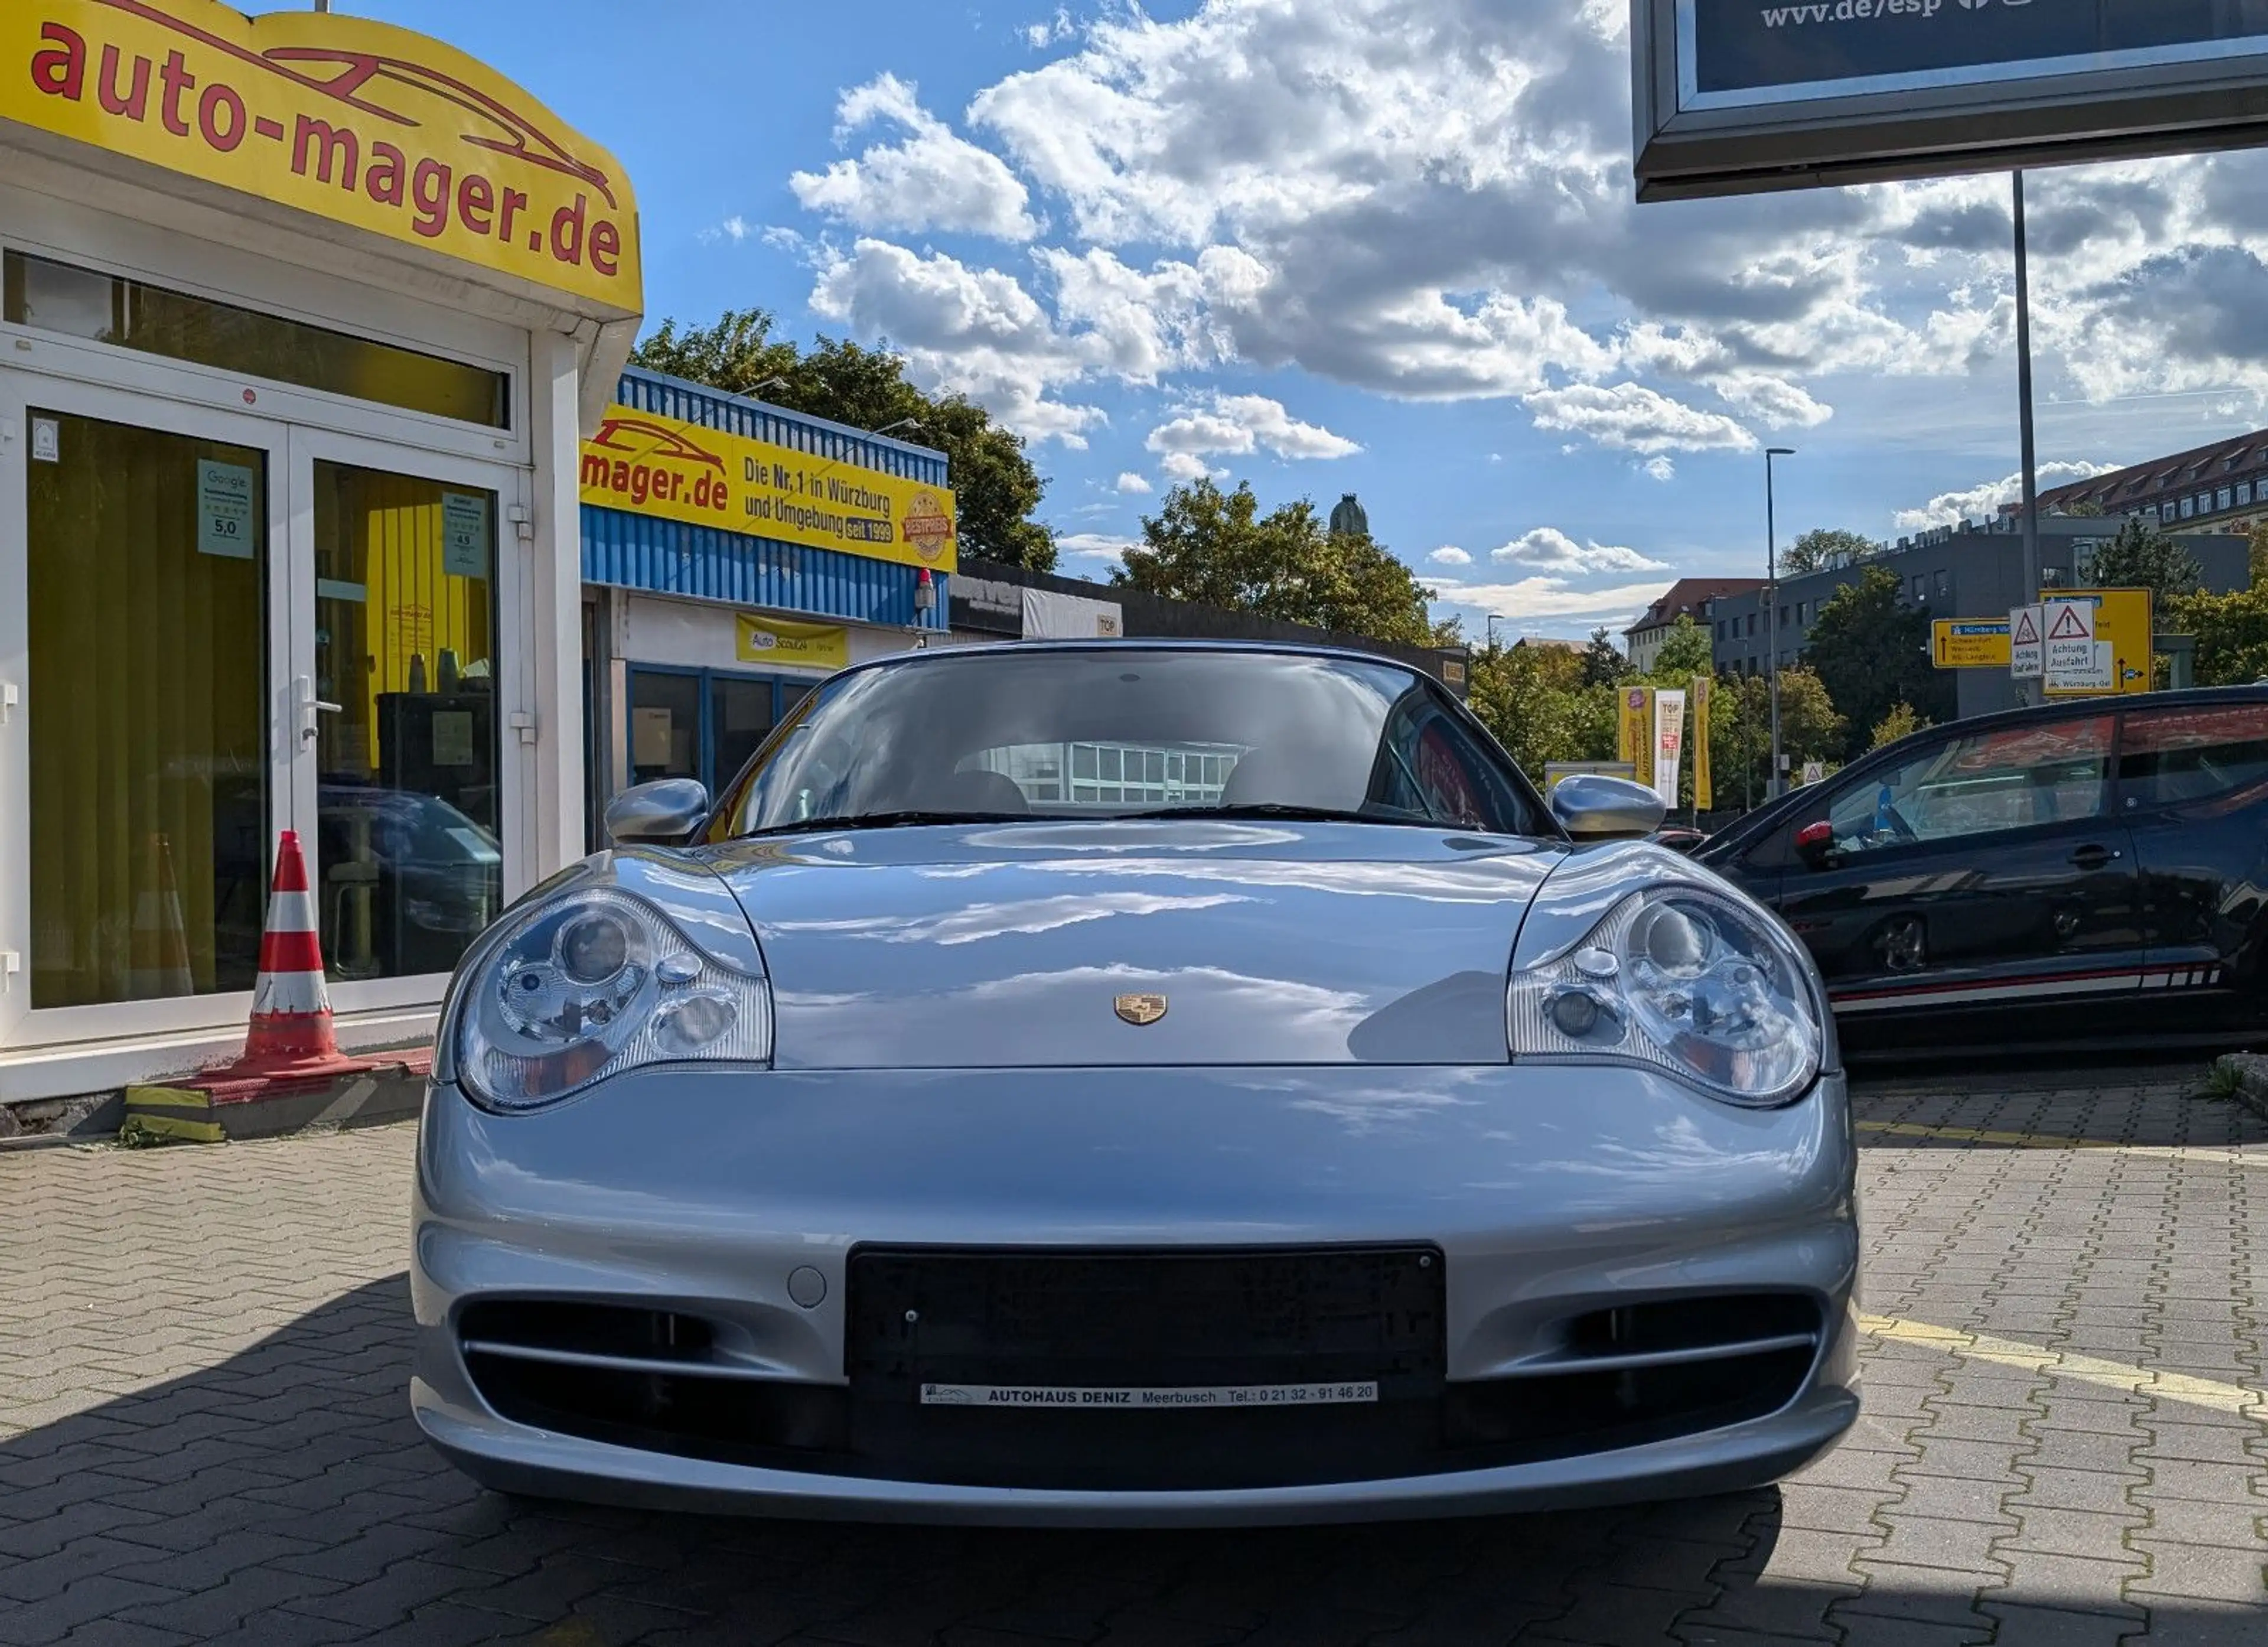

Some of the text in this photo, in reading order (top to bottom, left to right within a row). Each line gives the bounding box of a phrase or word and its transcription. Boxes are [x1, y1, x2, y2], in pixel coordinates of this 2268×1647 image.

[31, 21, 621, 276] auto-mager.de
[581, 453, 728, 511] mager.de
[744, 457, 890, 519] Die Nr. 1 in Würzburg
[215, 519, 236, 538] 5,0
[745, 494, 892, 541] und Umgebung seit 1999
[2051, 656, 2088, 668] Ausfahrt
[2052, 644, 2087, 655] Achtung
[989, 1390, 1077, 1403] AUTOHAUS
[1083, 1391, 1131, 1403] DENIZ
[1142, 1391, 1216, 1404] Meerbusch
[1228, 1390, 1256, 1402] Tel.:
[1260, 1389, 1269, 1401] 0
[1272, 1389, 1286, 1401] 21
[1291, 1388, 1307, 1400] 32
[1318, 1387, 1332, 1399] 91
[1337, 1386, 1353, 1398] 46
[1357, 1386, 1373, 1398] 20
